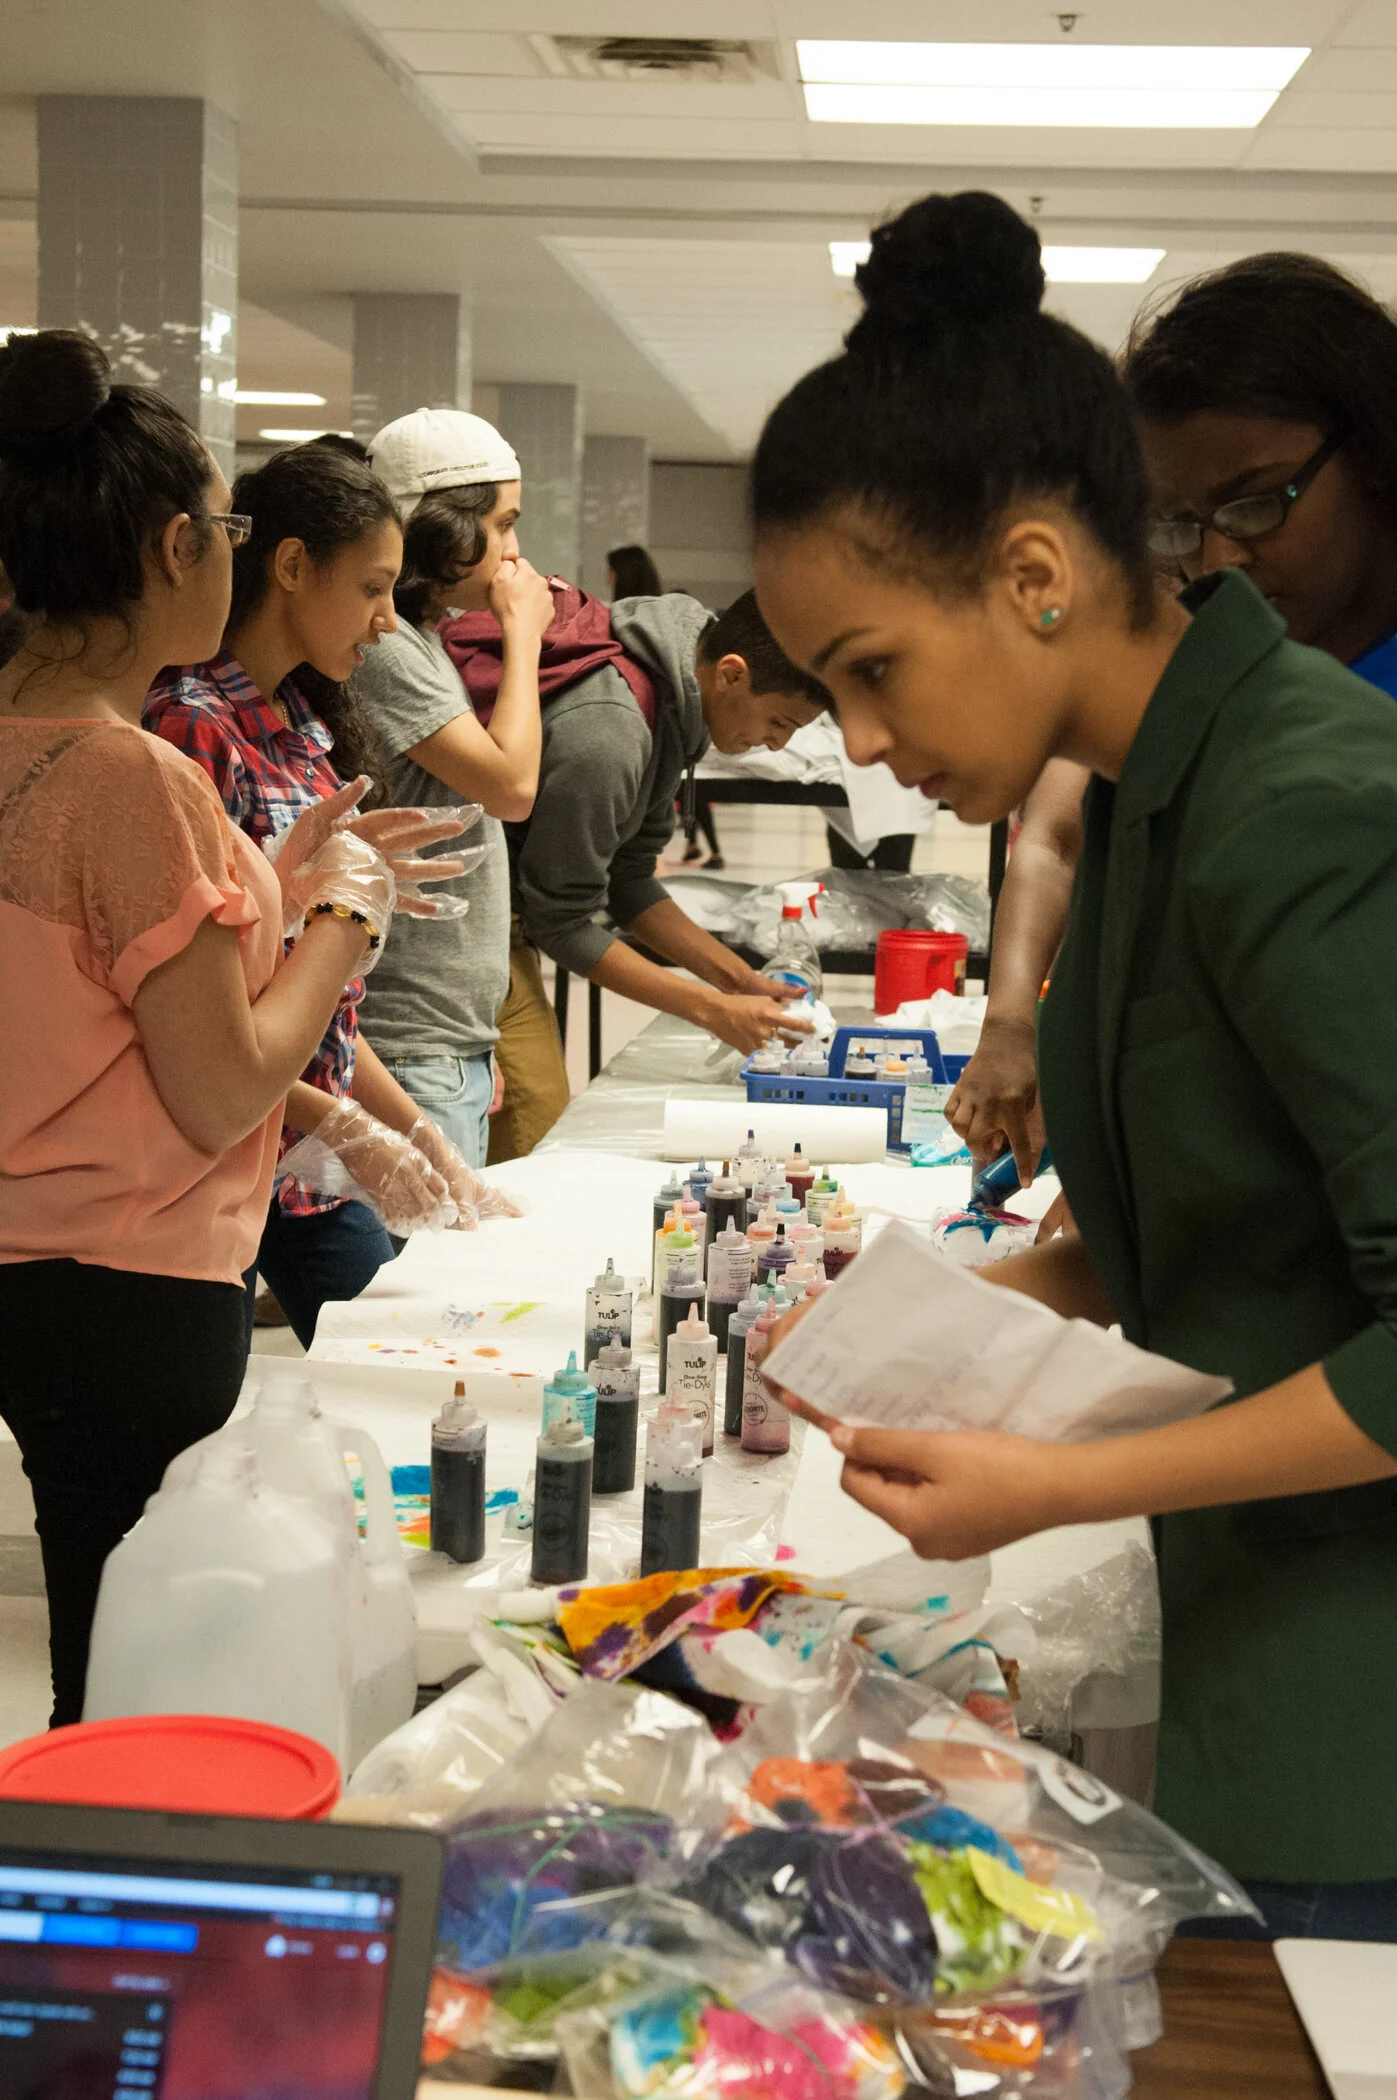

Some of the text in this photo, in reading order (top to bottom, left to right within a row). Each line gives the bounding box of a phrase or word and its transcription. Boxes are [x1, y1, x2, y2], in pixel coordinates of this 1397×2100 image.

[597, 1308, 620, 1320] TULIP
[684, 1356, 707, 1368] TULIP
[678, 1379, 711, 1390] Tie-Dye
